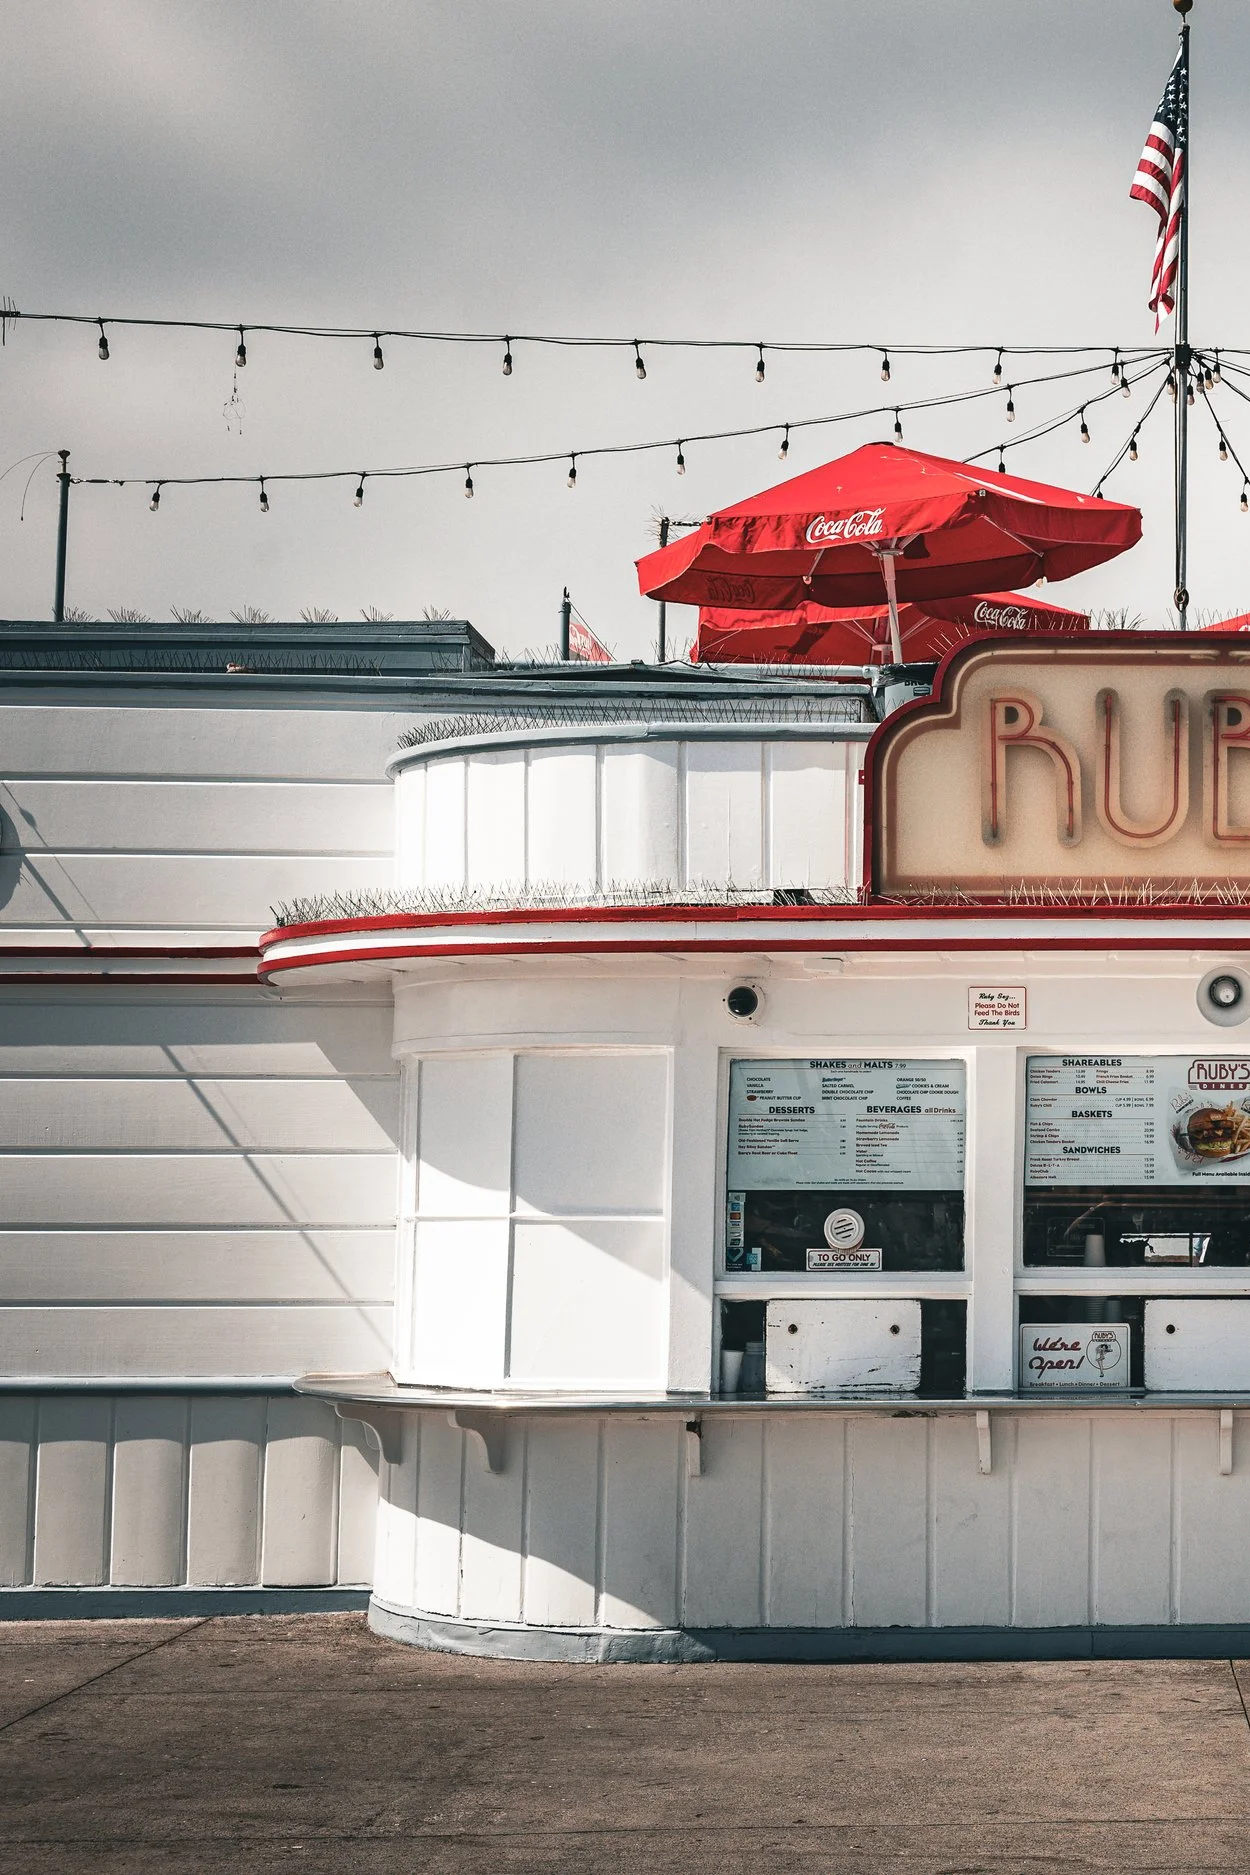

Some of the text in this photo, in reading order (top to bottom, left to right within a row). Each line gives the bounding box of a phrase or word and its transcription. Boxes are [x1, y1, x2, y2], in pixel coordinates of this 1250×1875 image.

[806, 508, 886, 544] Coca-Cola
[974, 601, 1029, 630] Coca-Cola
[1197, 1064, 1250, 1080] RUBY'S
[1033, 1337, 1081, 1351] We're
[1028, 1355, 1085, 1379] Open!
